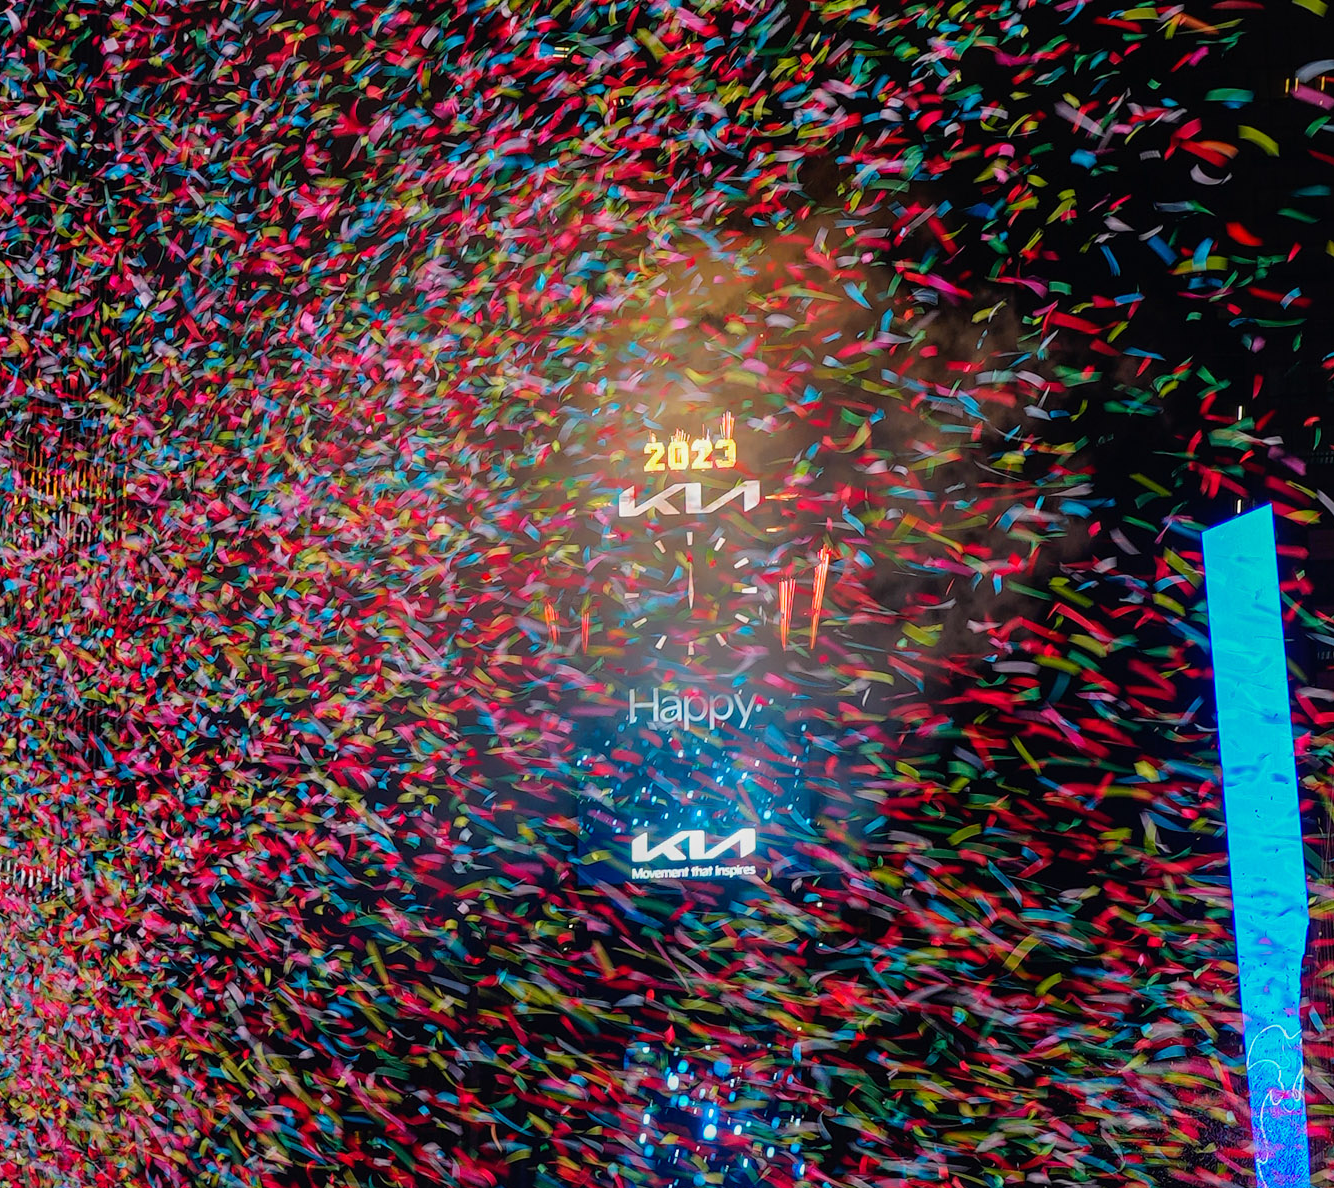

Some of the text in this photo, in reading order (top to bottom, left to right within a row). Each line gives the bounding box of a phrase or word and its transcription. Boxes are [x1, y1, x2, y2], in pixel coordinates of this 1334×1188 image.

[643, 439, 737, 473] 2023
[618, 480, 761, 518] KIA
[628, 687, 757, 731] Happy
[631, 827, 758, 863] KIA
[631, 865, 757, 880] Movement that inspires
